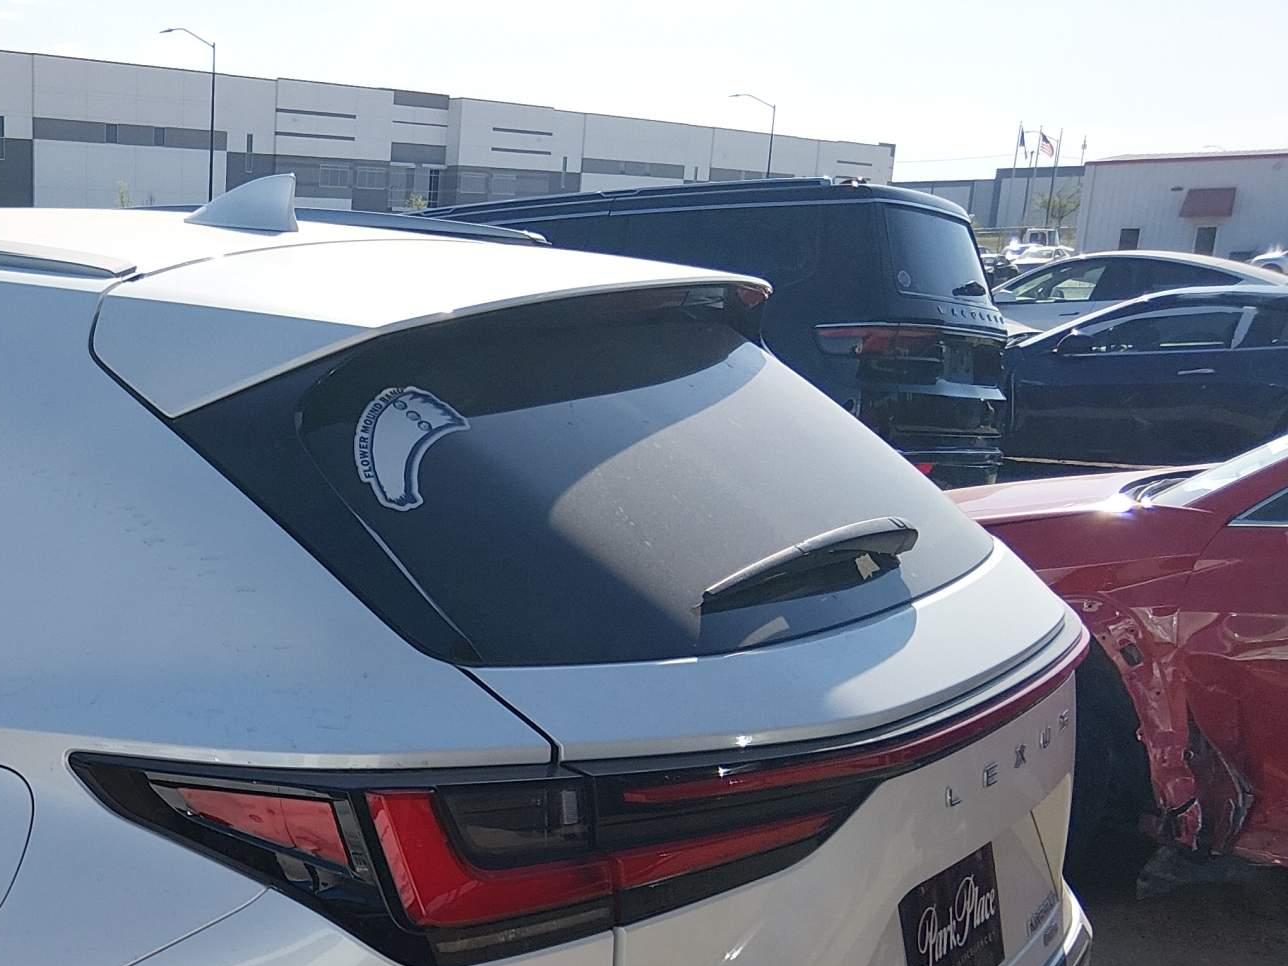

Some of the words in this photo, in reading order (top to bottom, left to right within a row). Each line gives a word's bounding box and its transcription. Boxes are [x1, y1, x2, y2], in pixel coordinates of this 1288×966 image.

[361, 402, 383, 434] MOUND
[359, 436, 374, 479] FLOWER
[945, 708, 1070, 807] LEXUS
[955, 874, 996, 946] Place
